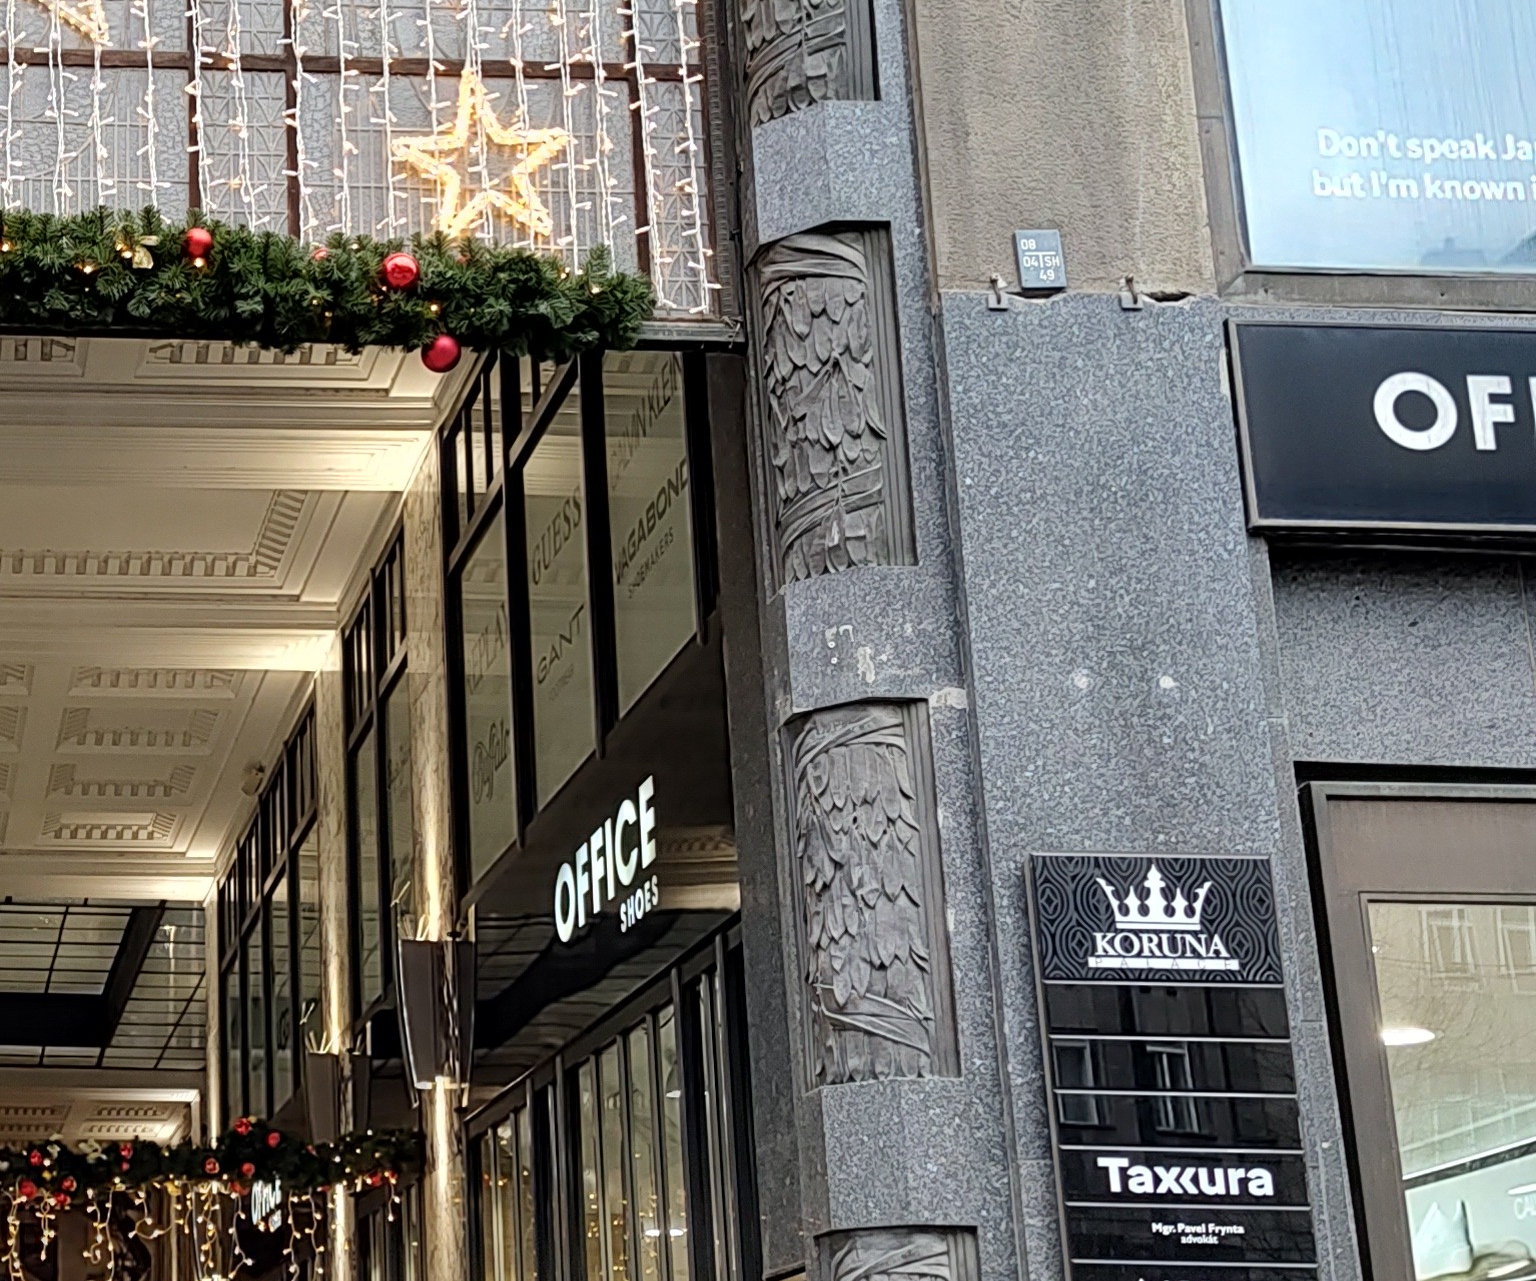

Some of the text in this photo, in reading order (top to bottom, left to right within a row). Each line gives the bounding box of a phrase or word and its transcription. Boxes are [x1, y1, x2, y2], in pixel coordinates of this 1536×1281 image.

[1318, 128, 1402, 160] Don't
[1407, 133, 1494, 164] speak
[1312, 171, 1366, 199] but
[1371, 171, 1418, 199] I'm
[1424, 174, 1526, 202] known
[1021, 239, 1036, 250] 08
[1040, 270, 1055, 281] 49
[1372, 372, 1536, 452] OF
[532, 484, 581, 587] GUESS
[536, 603, 585, 686] GANT
[554, 775, 657, 942] OFFICE
[619, 874, 659, 933] SHOES
[1092, 932, 1231, 958] KORUNA
[1151, 1222, 1245, 1236] Mgr. Pavel Frynta
[1180, 1235, 1219, 1245] advokát
